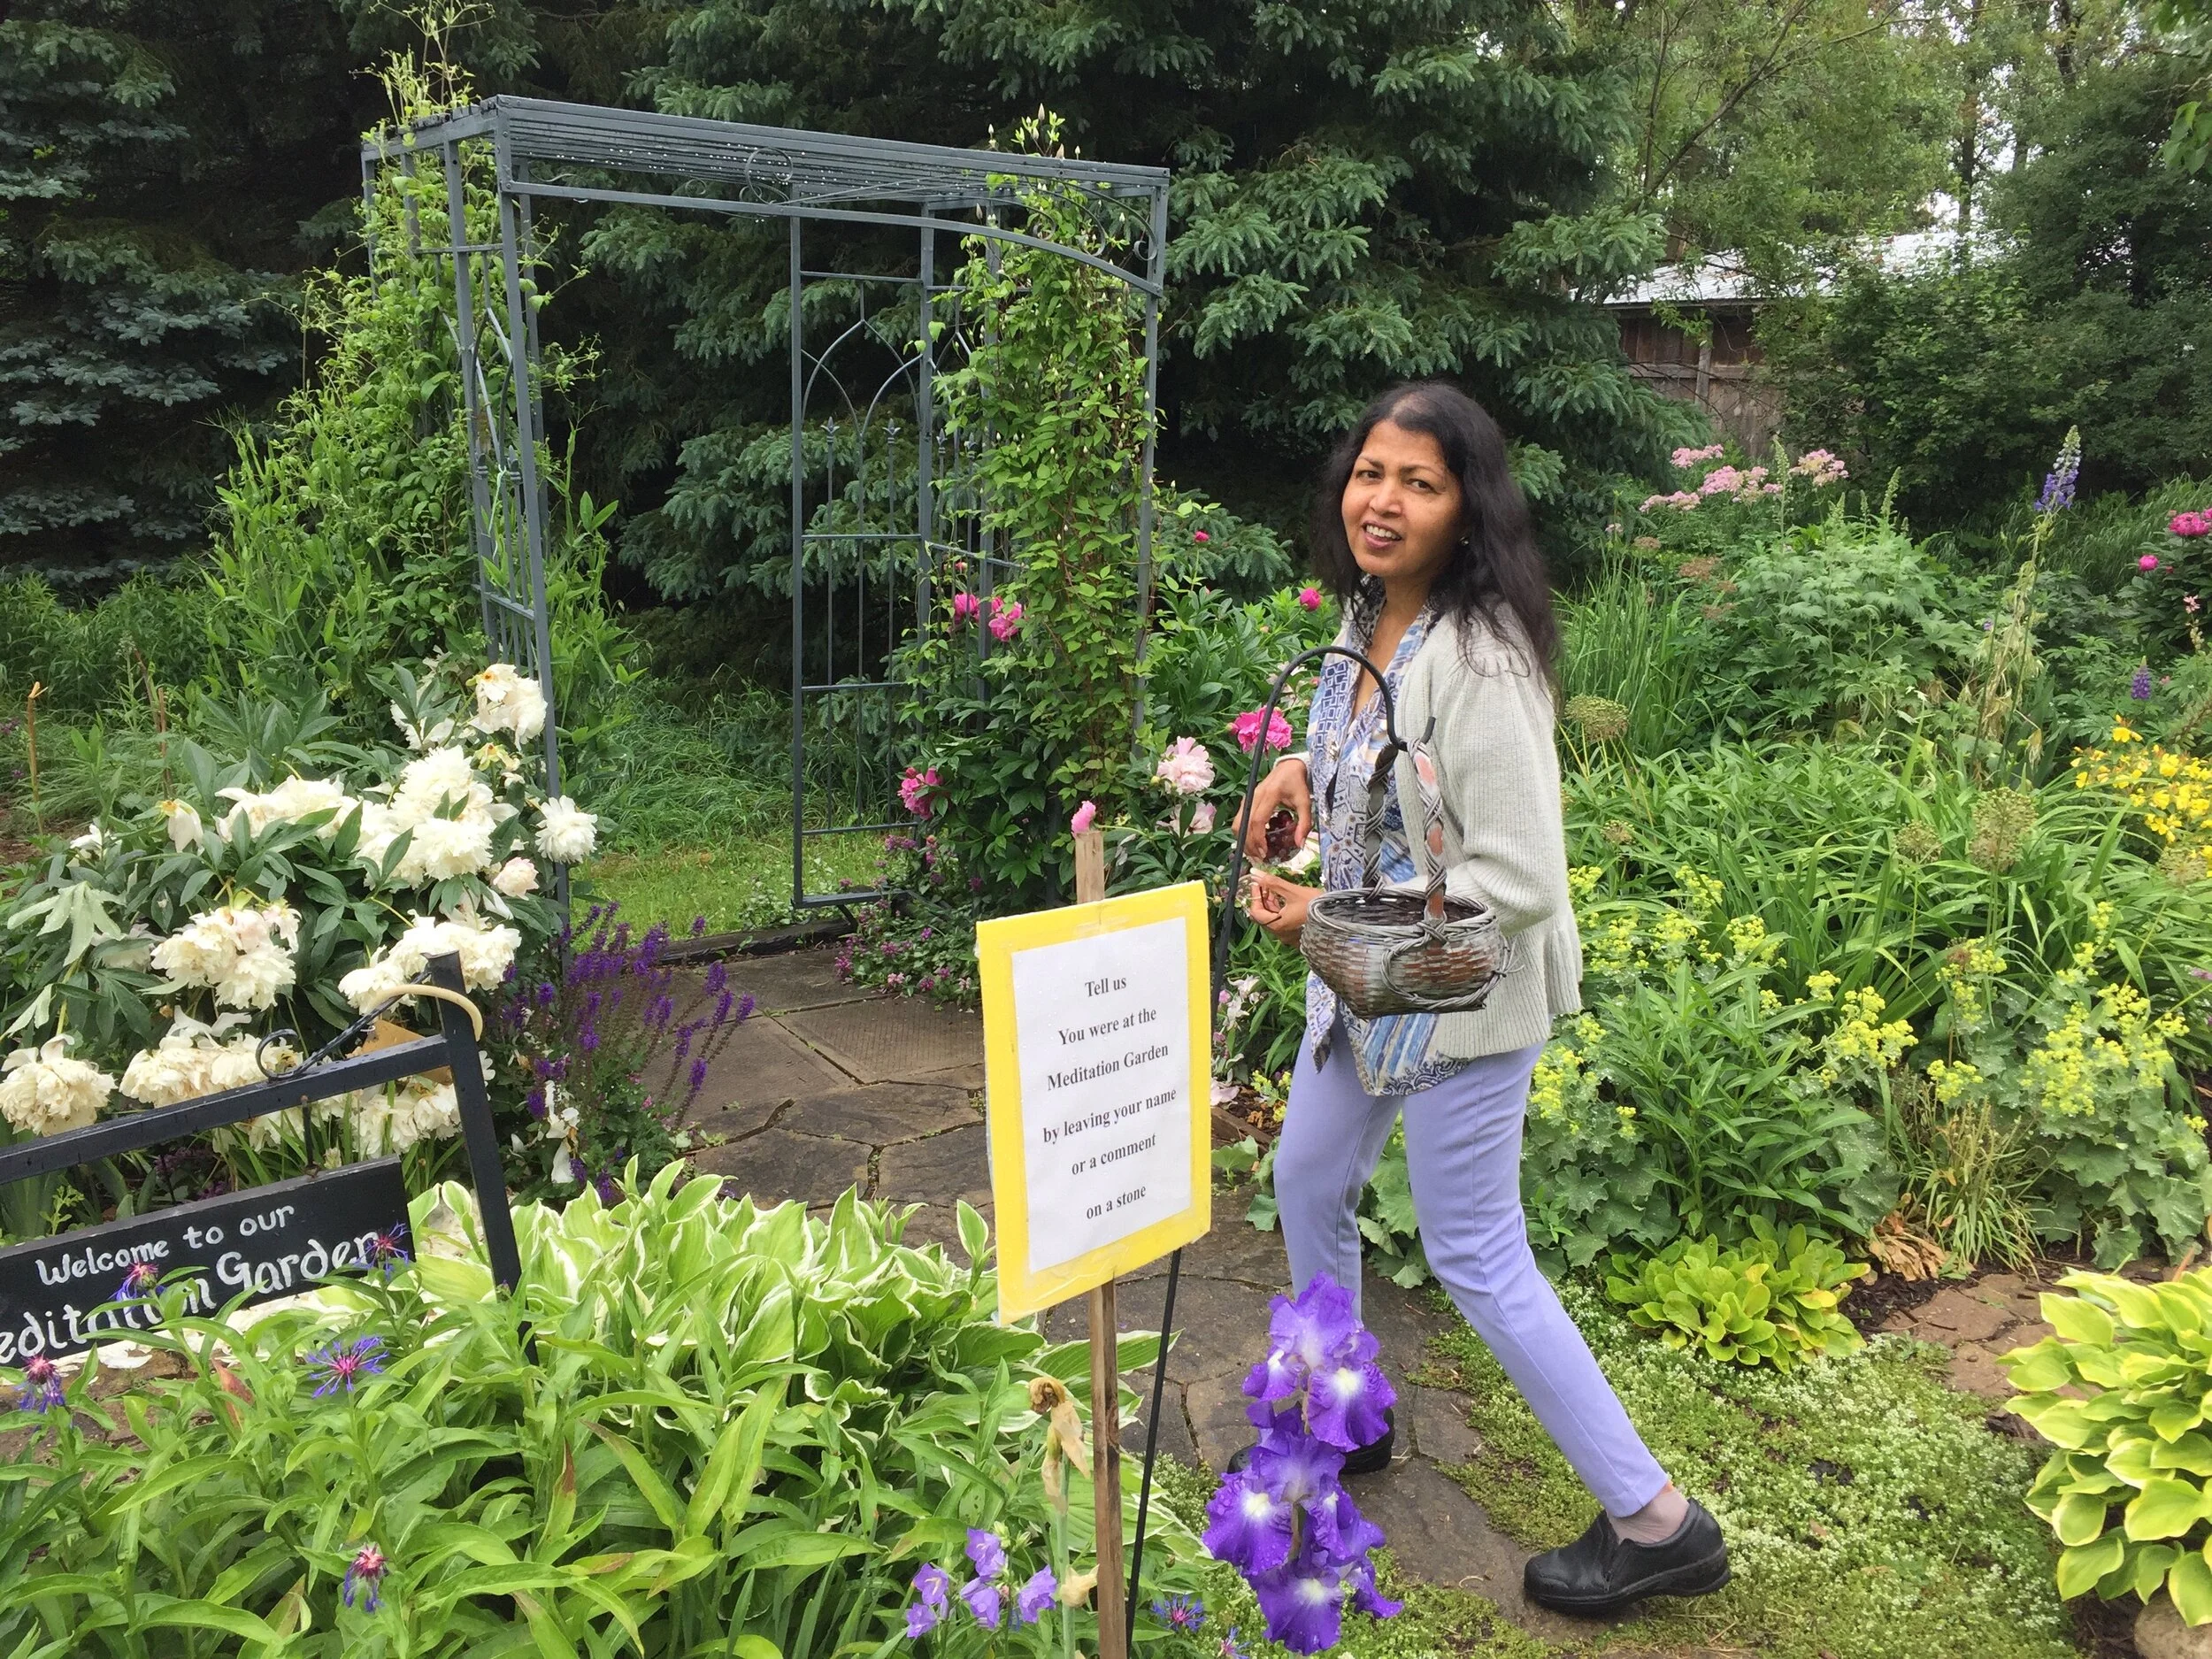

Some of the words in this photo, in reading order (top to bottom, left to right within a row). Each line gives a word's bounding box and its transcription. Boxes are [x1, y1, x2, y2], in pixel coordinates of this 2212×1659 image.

[1084, 977, 1110, 997] Tell
[1112, 977, 1127, 991] us
[1057, 1028, 1085, 1046] You
[1088, 1019, 1119, 1038] were
[1122, 1012, 1135, 1029] at
[1138, 1008, 1156, 1025] the
[1047, 1060, 1120, 1091] Meditation
[1123, 1045, 1169, 1068] Garden
[1042, 1127, 1060, 1145] by
[1064, 1111, 1111, 1137] leaving
[1113, 1100, 1142, 1125] your
[1145, 1089, 1177, 1110] name
[1071, 1160, 1087, 1176] or
[1089, 1156, 1097, 1170] a
[1100, 1133, 1156, 1165] comment
[1086, 1203, 1102, 1220] on
[1106, 1200, 1113, 1212] a
[1116, 1186, 1147, 1208] stone
[36, 1241, 169, 1286] Welcome
[182, 1225, 224, 1249] to
[239, 1205, 295, 1237] our
